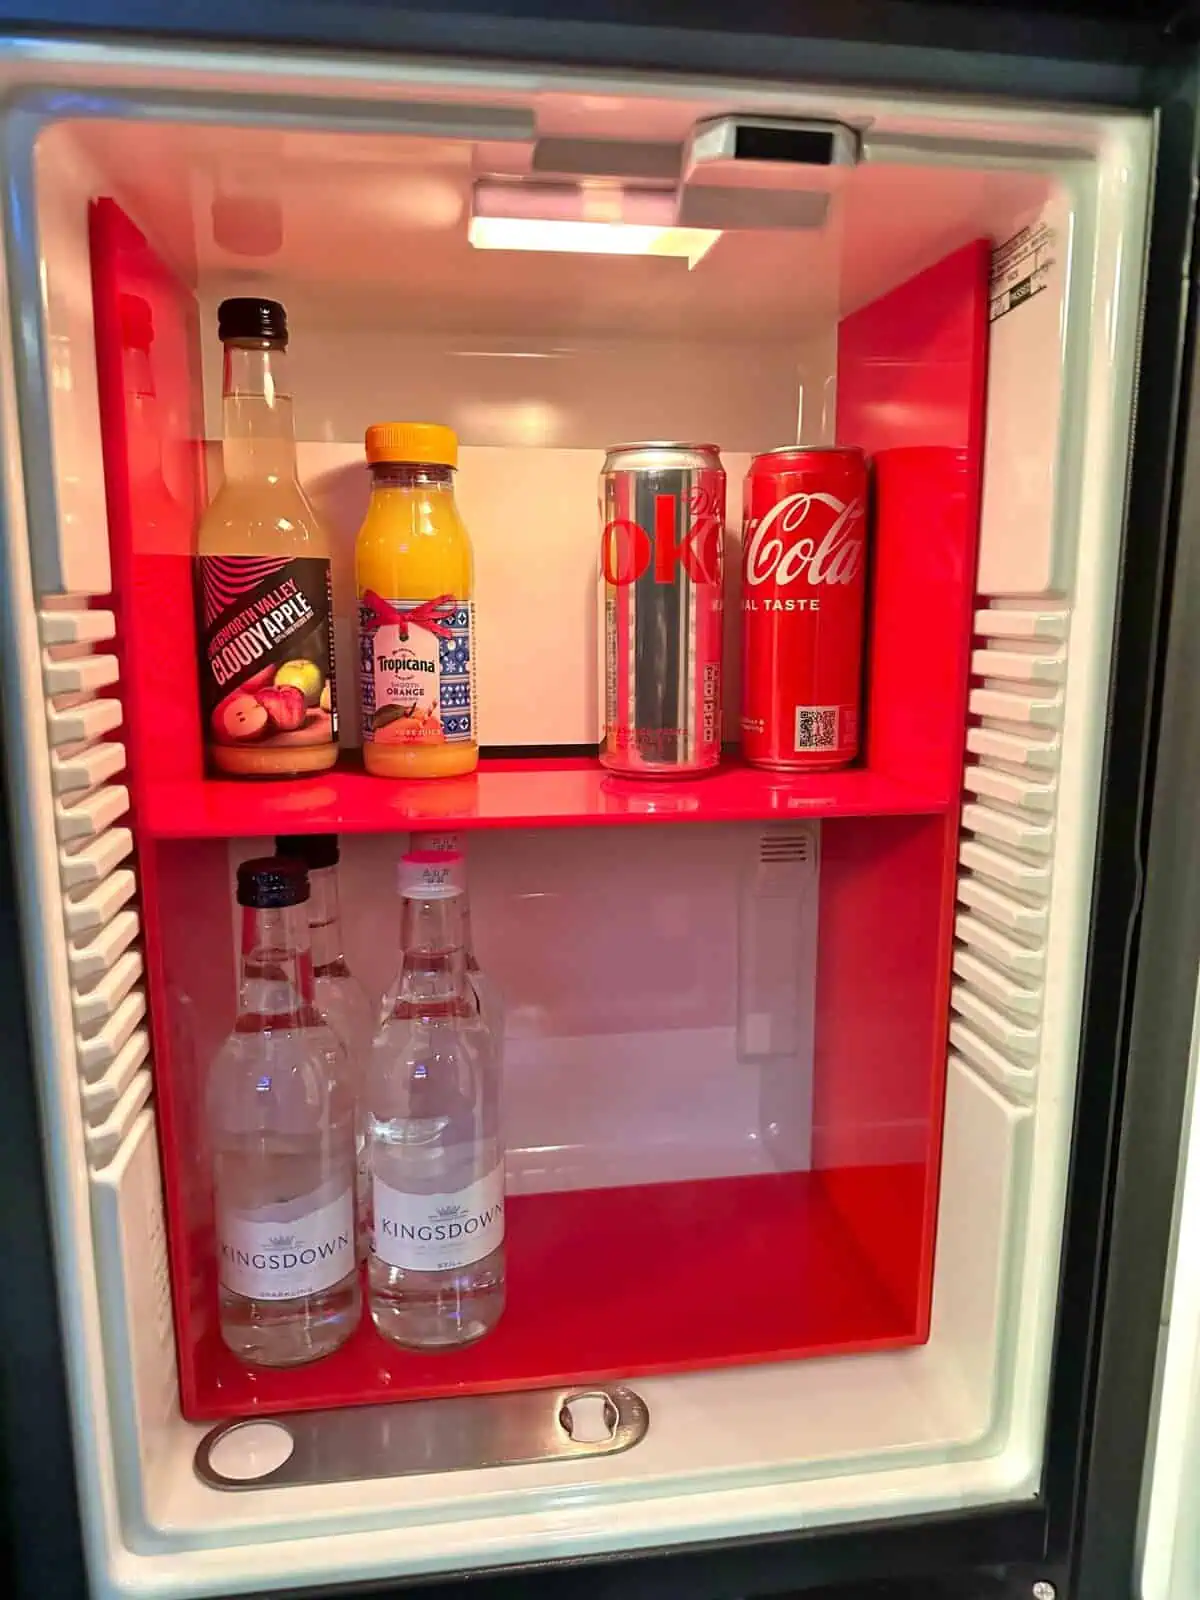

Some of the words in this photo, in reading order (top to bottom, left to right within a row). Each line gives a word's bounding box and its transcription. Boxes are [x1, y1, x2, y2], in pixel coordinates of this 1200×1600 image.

[253, 577, 299, 615] VALLEY
[763, 599, 820, 611] TASTE
[211, 621, 273, 686] CLOUDY
[262, 592, 312, 638] APPLE
[377, 656, 435, 673] Tropicana
[386, 688, 425, 696] ORANGE
[382, 1201, 503, 1241] KINGSDOWN
[221, 1231, 348, 1270] KINGSDOWN
